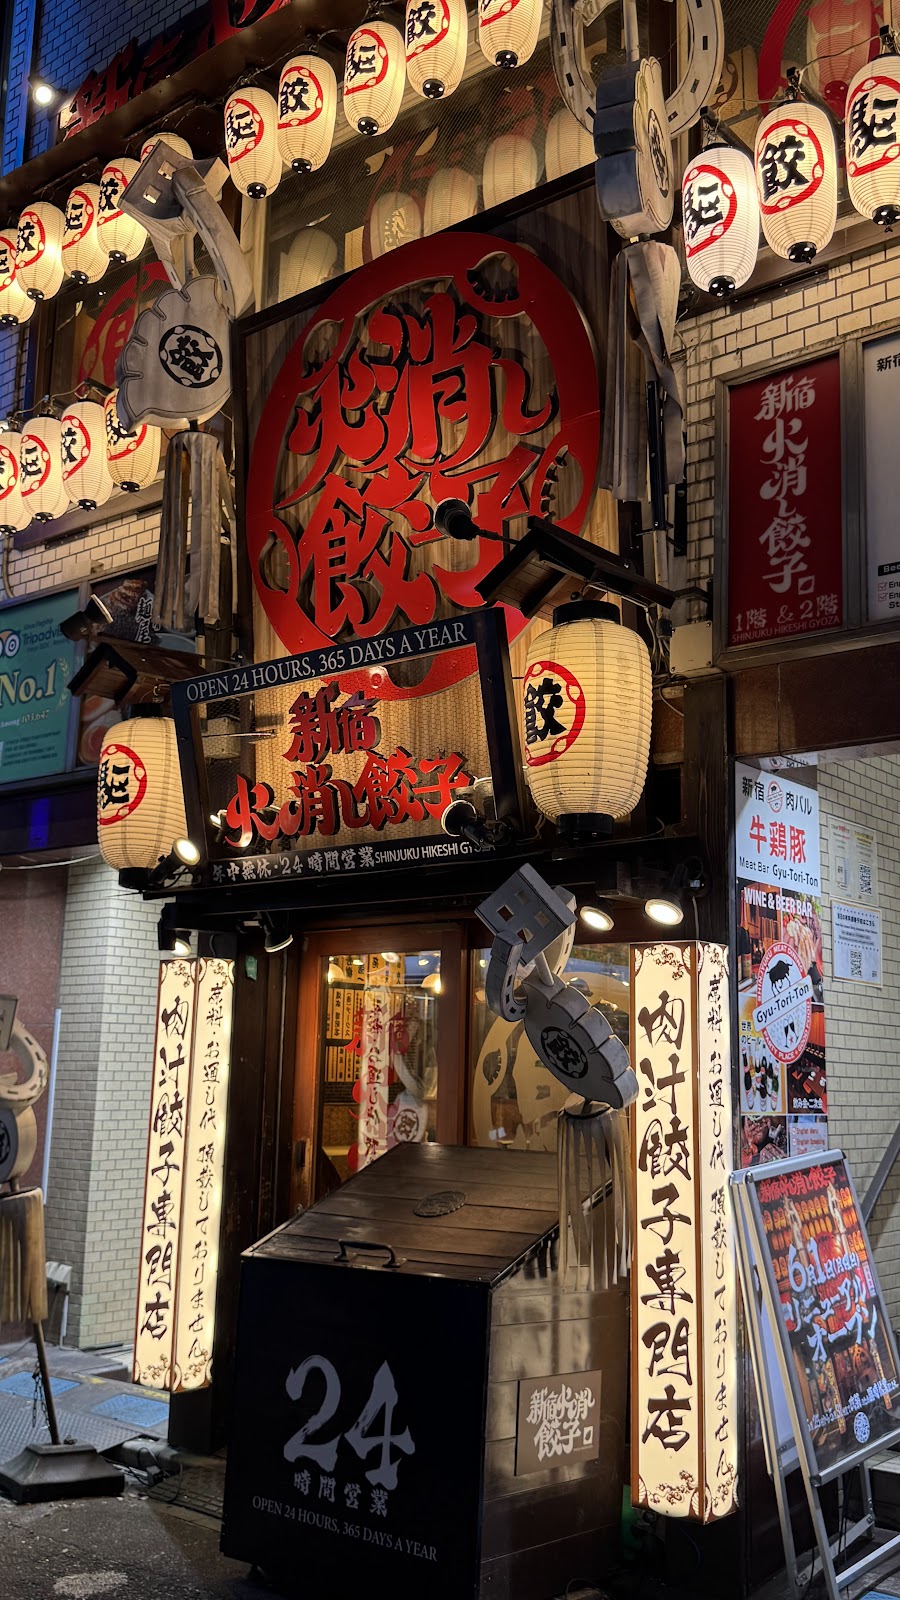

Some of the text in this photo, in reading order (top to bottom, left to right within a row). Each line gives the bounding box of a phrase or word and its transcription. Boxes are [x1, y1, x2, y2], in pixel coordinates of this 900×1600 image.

[759, 134, 809, 202] 餃
[753, 375, 817, 421] 新宿
[758, 417, 811, 595] 火消し餃子
[298, 442, 542, 638] 餃子
[22, 627, 63, 646] Tripadvis
[731, 614, 840, 644] SHINJUKU HIKESHI GYOZA
[735, 593, 838, 633] 1階 & 2階
[0, 660, 56, 705] No.1
[186, 622, 467, 702] OPEN 24 HOURS, 365 DAYS A YEAR
[283, 682, 380, 763] 新宿
[224, 747, 478, 848] 火消し餃子
[741, 776, 813, 815] 新宿 肉バル
[375, 848, 420, 864] SHINJUKU
[421, 843, 459, 859] HIKESHI
[749, 815, 807, 864] 牛鶏豚
[739, 856, 819, 887] Meat Bar Gyu-Tori-Ton
[744, 887, 813, 917] WINE & BEER BAR
[756, 984, 810, 1023] Gyu-Tori-Ton
[807, 1304, 877, 1362] オープン
[283, 1354, 416, 1490] 24
[293, 1469, 389, 1518] 時間営業
[252, 1495, 438, 1562] OPEN 24 HOURS, 365 DAYS A YEAR
